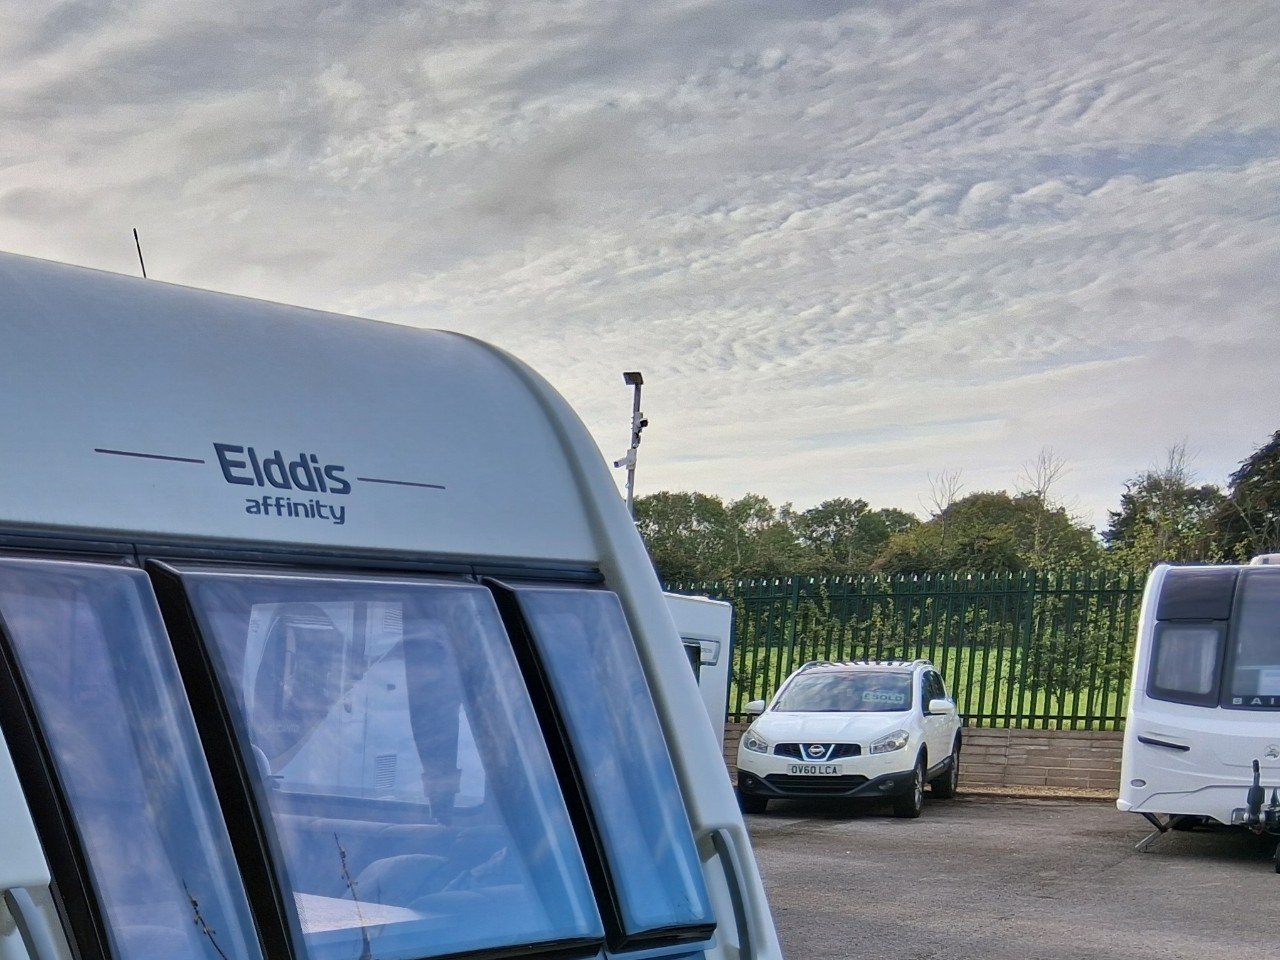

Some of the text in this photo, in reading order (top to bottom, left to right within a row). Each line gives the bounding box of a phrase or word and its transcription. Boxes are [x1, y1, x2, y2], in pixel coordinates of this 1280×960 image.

[213, 442, 351, 495] Elddis
[245, 496, 345, 525] affinity
[791, 765, 838, 775] OV60 LCA
